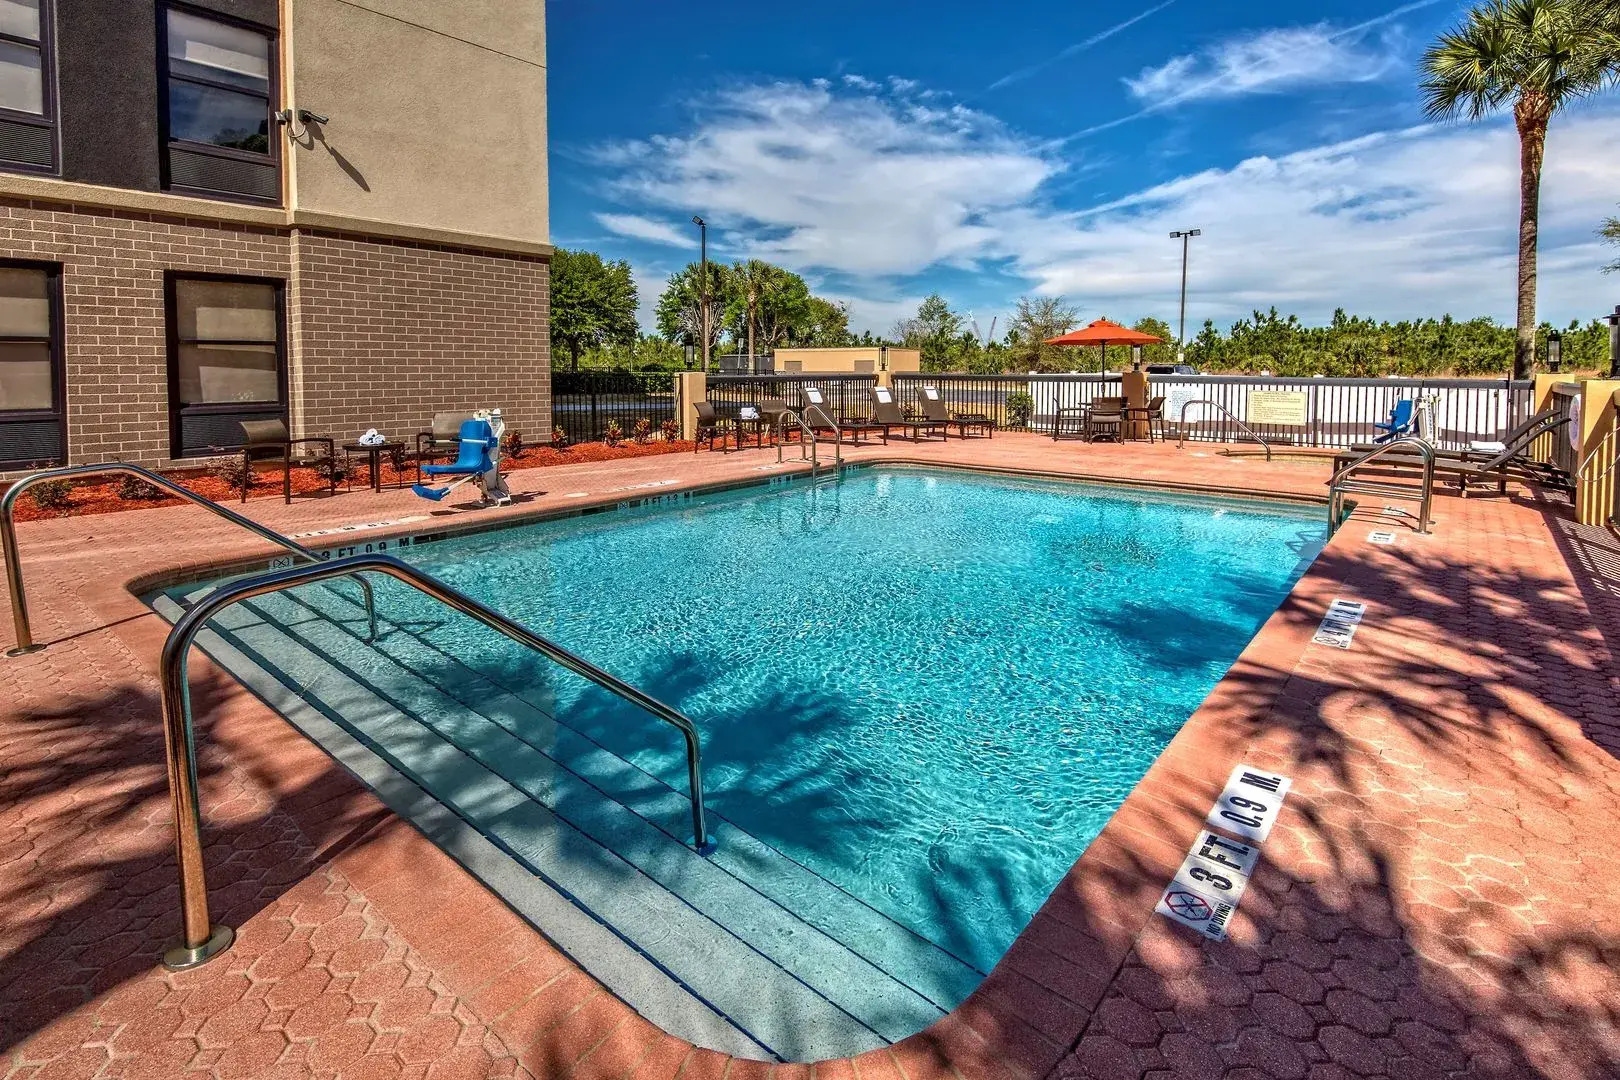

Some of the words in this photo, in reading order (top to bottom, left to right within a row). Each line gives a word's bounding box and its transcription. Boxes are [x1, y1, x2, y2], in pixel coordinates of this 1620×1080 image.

[338, 546, 356, 558] FT
[399, 538, 410, 547] M
[1189, 867, 1233, 891] 3
[1220, 796, 1268, 828] 0.9
[1211, 902, 1232, 926] DIVING
[1206, 923, 1222, 937] NO
